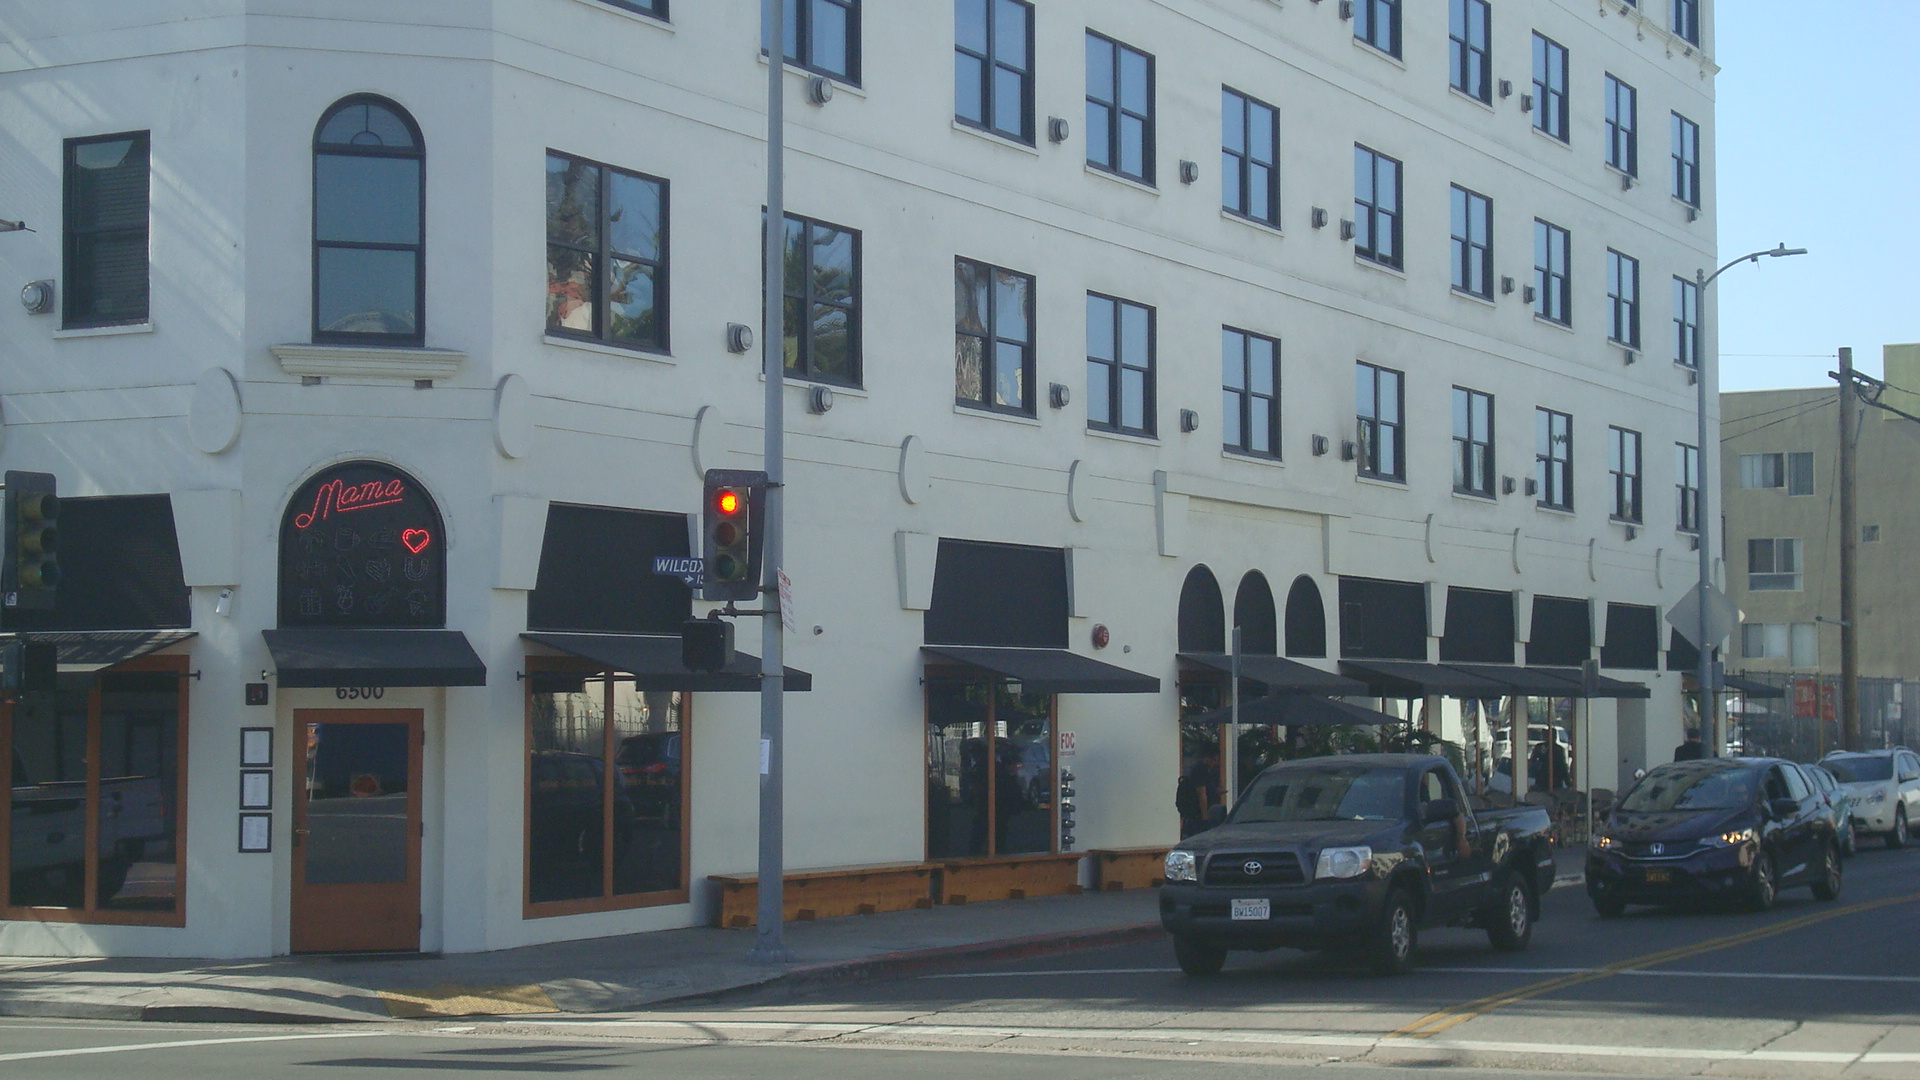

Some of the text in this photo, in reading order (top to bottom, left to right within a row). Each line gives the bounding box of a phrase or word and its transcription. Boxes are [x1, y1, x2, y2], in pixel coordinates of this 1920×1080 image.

[294, 478, 405, 529] Mama
[656, 558, 704, 573] WILCOX
[336, 686, 384, 700] 6500
[1060, 732, 1075, 749] FDC
